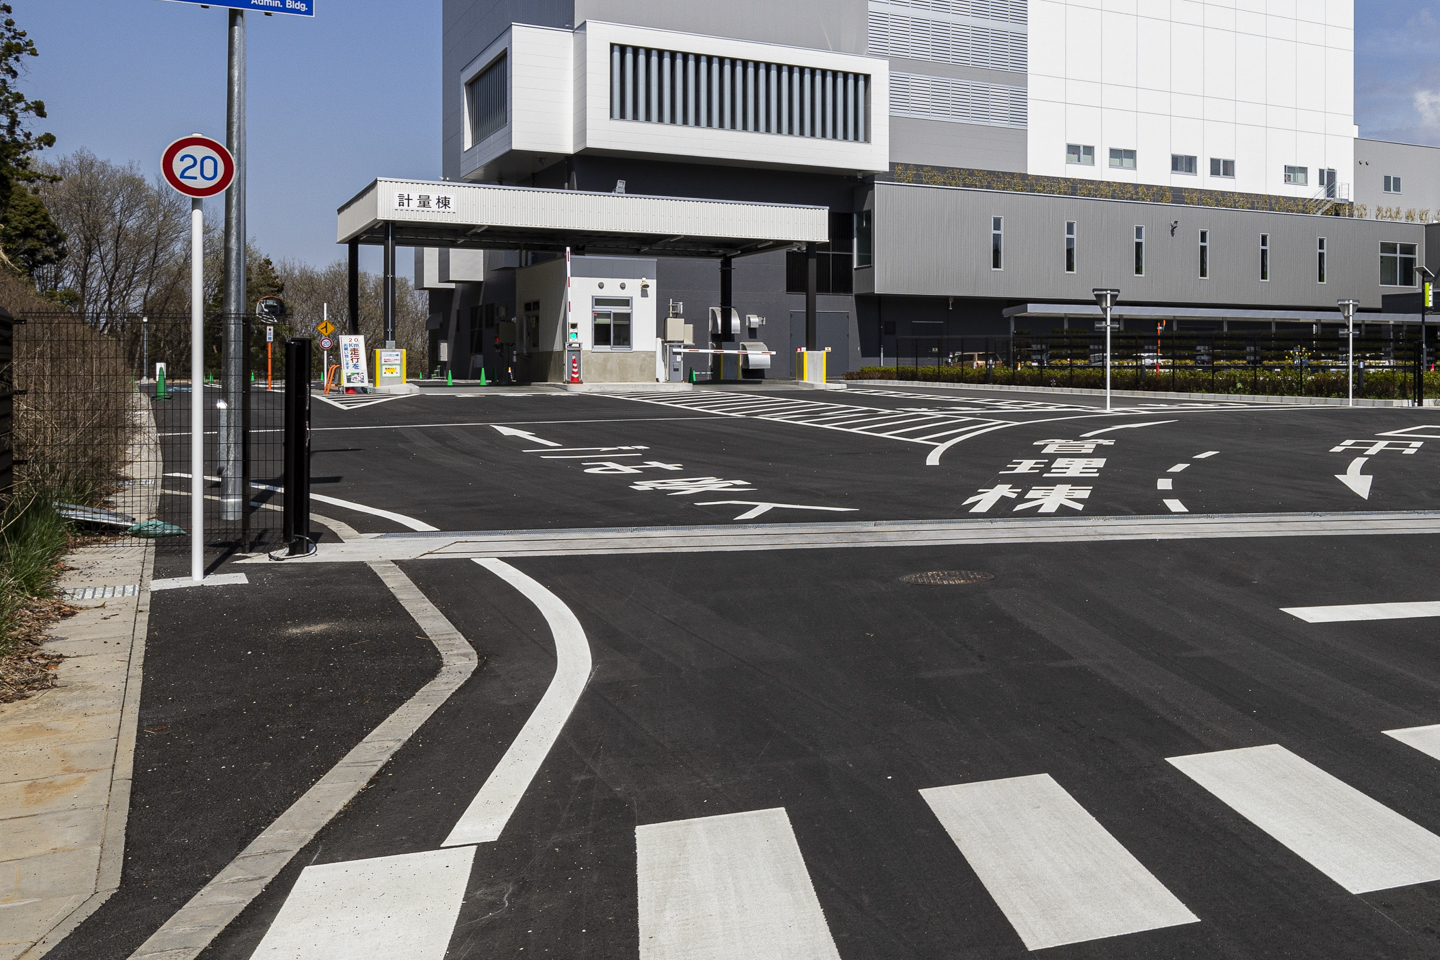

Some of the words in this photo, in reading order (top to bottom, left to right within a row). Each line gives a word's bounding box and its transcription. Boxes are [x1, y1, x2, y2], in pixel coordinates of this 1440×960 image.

[285, 0, 309, 12] Bldg.
[179, 153, 218, 181] 20
[397, 193, 451, 209] 計量棟
[350, 348, 360, 369] 走行を
[522, 445, 860, 521] ごみ受入
[961, 439, 1116, 513] 管理棟
